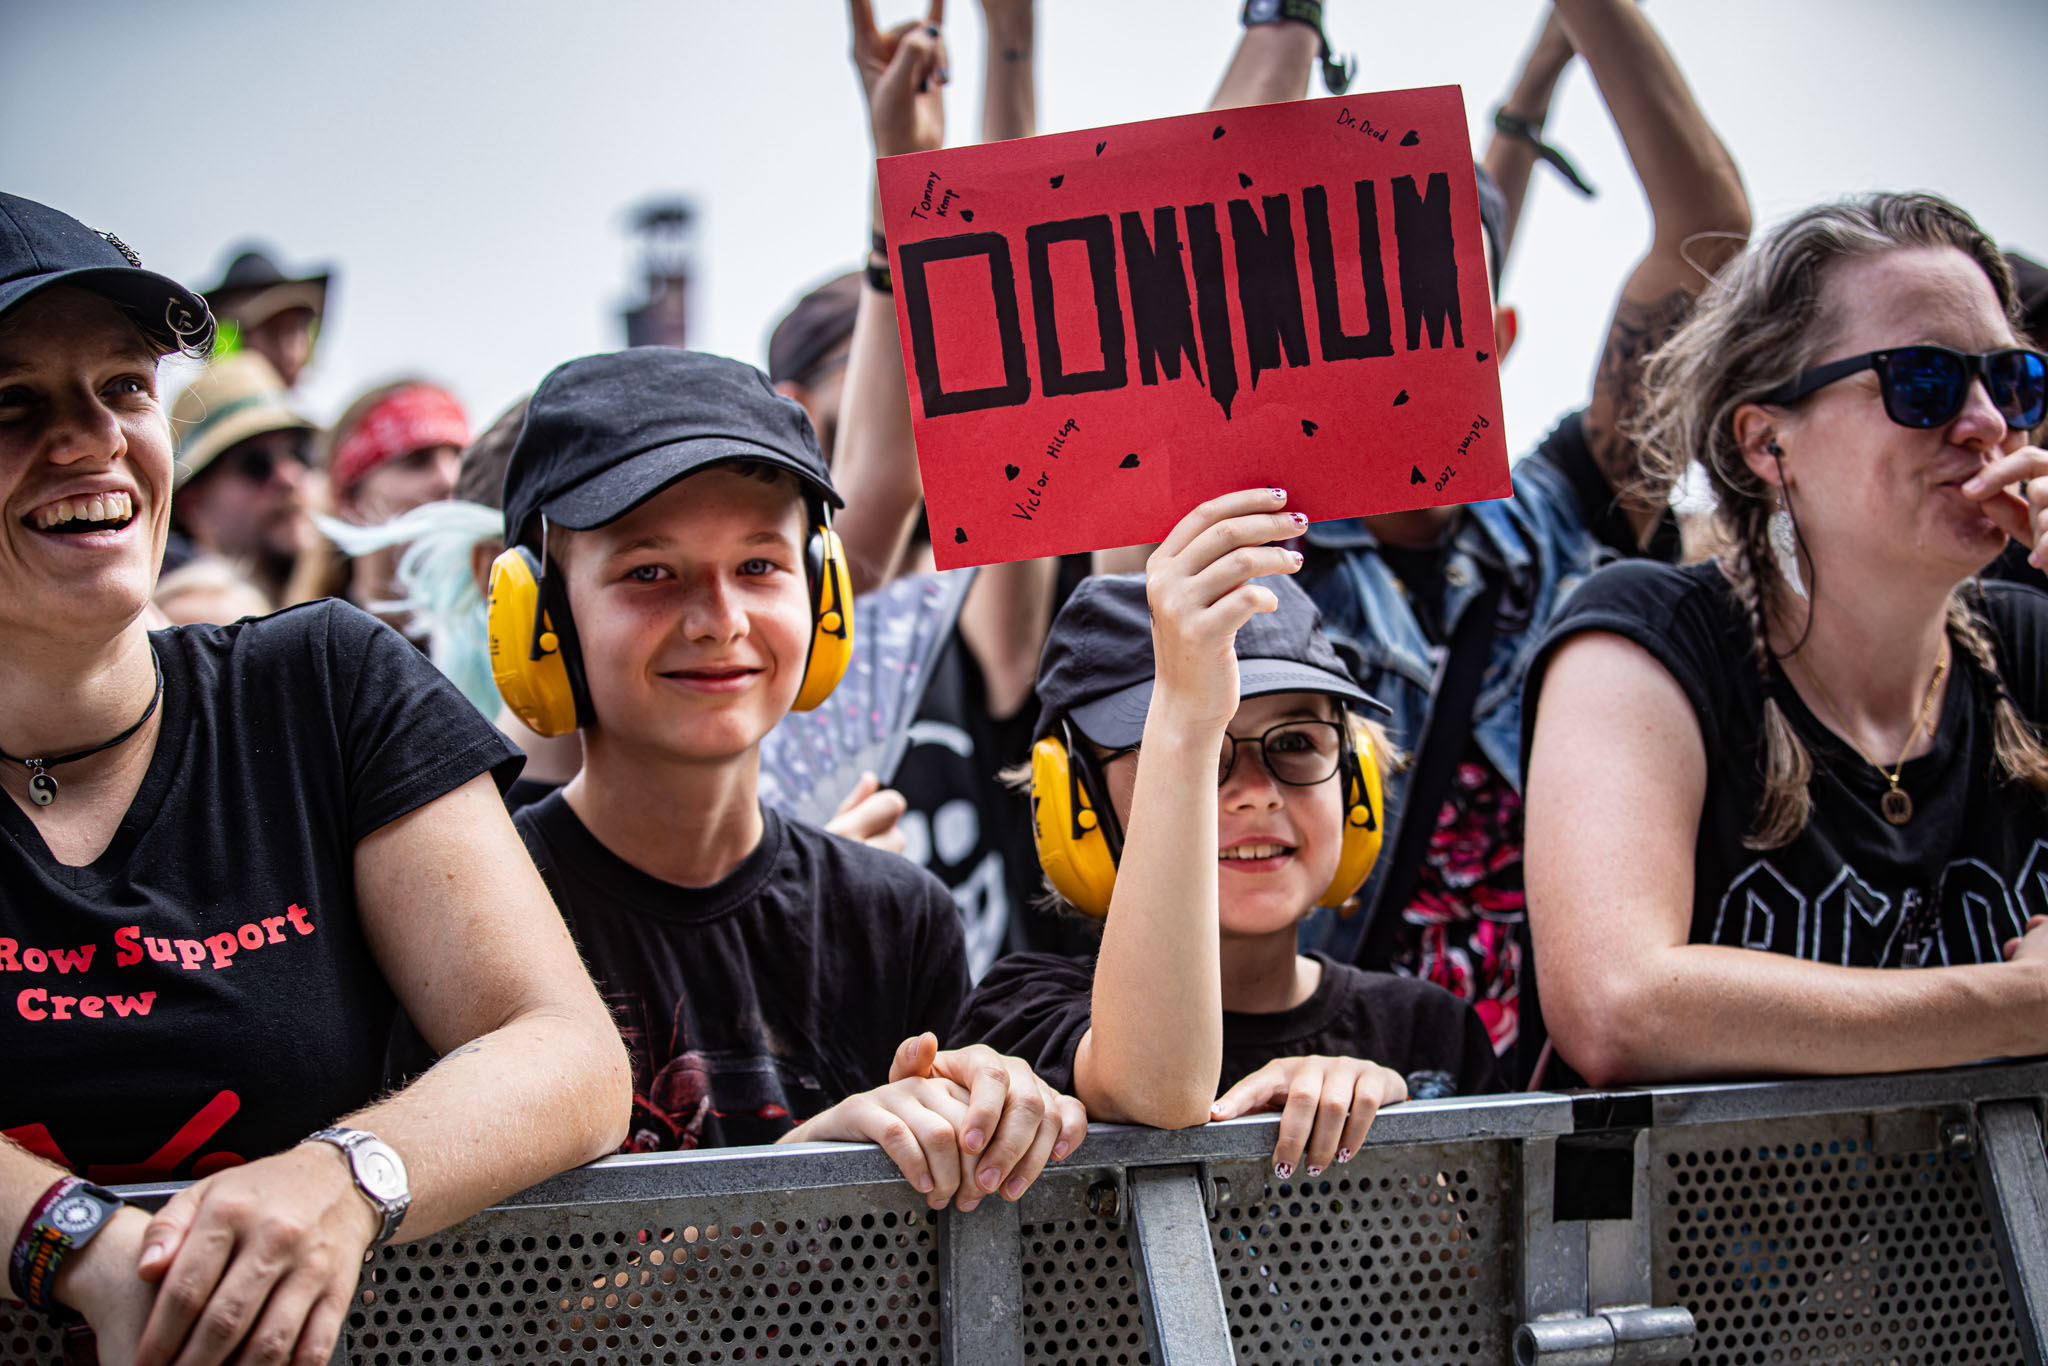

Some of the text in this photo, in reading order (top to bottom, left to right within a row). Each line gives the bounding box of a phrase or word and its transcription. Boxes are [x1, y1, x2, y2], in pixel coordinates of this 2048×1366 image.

[1336, 107, 1389, 143] Dr. Dead
[936, 188, 960, 218] Kemp
[898, 171, 1464, 422] DOMINUM
[1011, 471, 1050, 521] Victor
[0, 903, 316, 975] Row Support
[17, 988, 157, 1022] Crew
